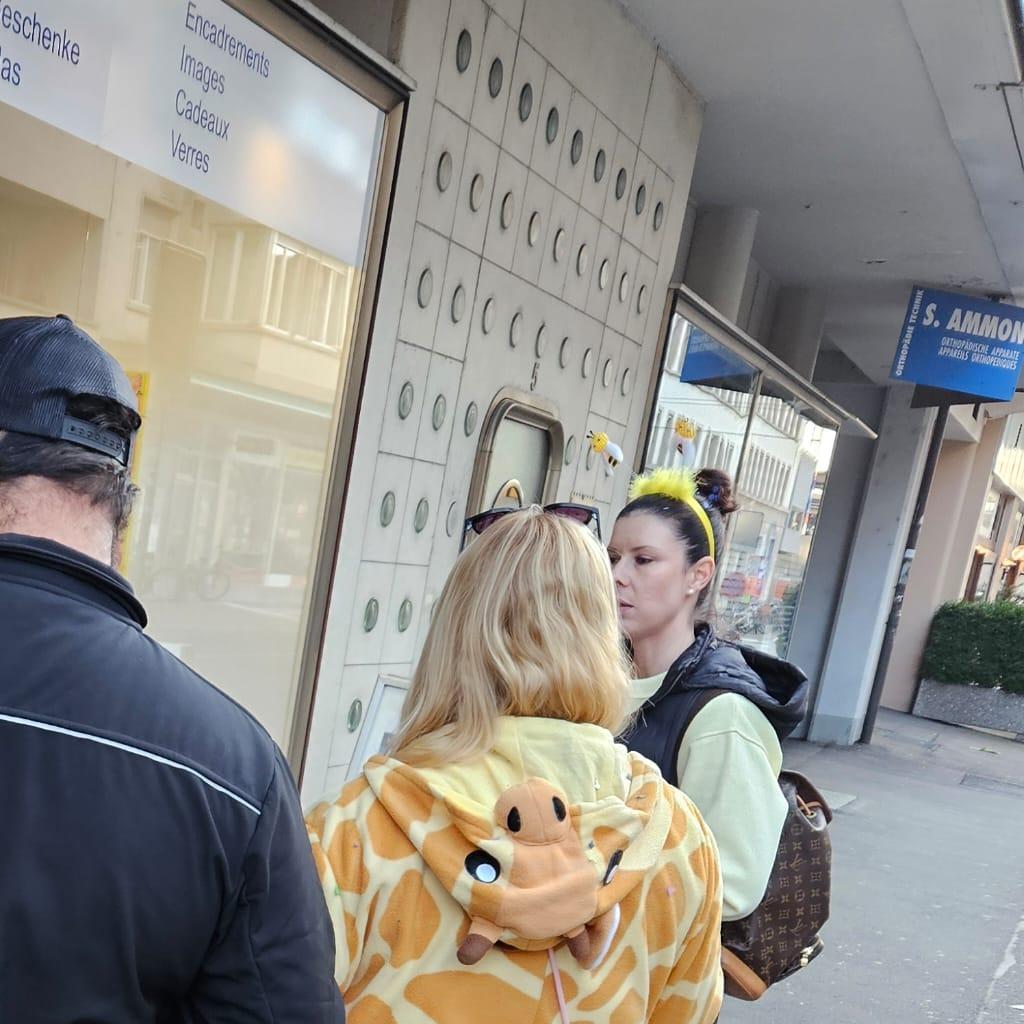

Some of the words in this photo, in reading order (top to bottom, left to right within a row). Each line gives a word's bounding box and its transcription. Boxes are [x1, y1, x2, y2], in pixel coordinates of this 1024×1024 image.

[185, 1, 270, 78] Encadrements
[180, 44, 225, 94] Images
[175, 88, 230, 141] Cadeaux
[170, 129, 210, 173] Verres
[909, 289, 925, 324] TECHNIK
[922, 303, 940, 328] S.
[946, 308, 1024, 345] AMMON
[937, 346, 969, 361] APPAREILS
[990, 346, 1020, 361] APPARATE
